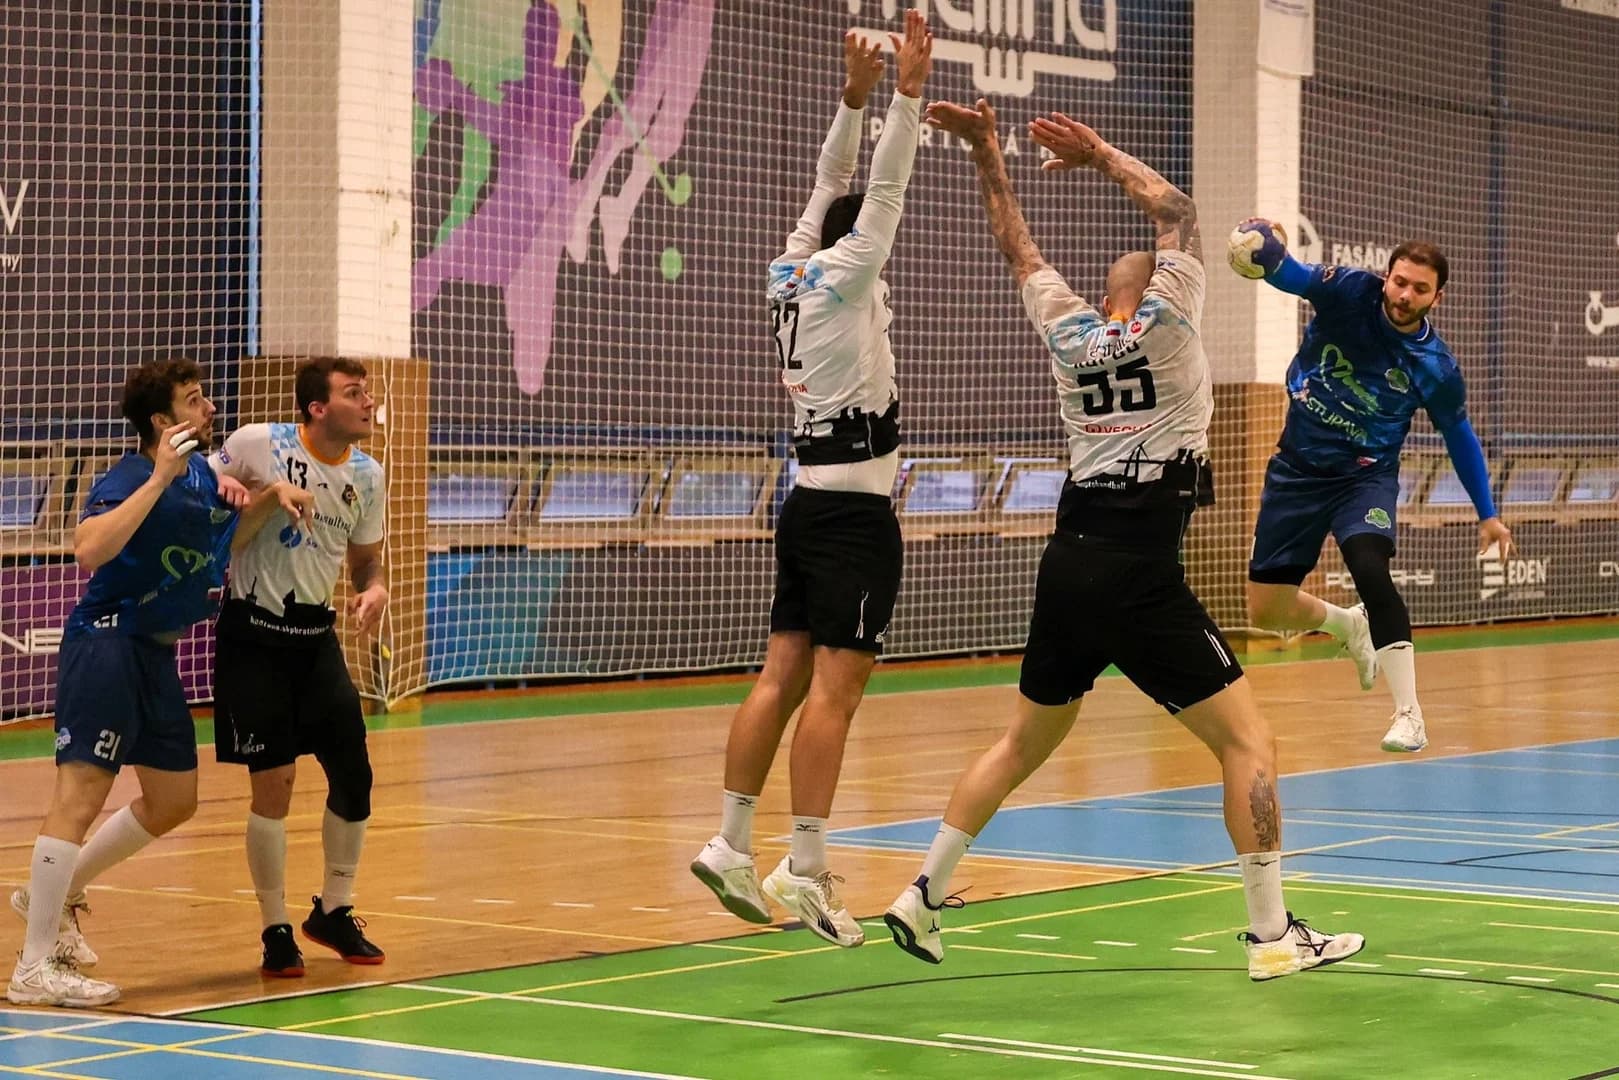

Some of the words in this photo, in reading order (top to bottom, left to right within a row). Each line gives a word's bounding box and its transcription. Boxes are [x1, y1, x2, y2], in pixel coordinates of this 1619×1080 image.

[1332, 241, 1392, 272] FASÁD
[1077, 355, 1157, 416] 55
[287, 456, 308, 490] 13
[1507, 559, 1547, 585] EDEN
[93, 729, 121, 762] 21
